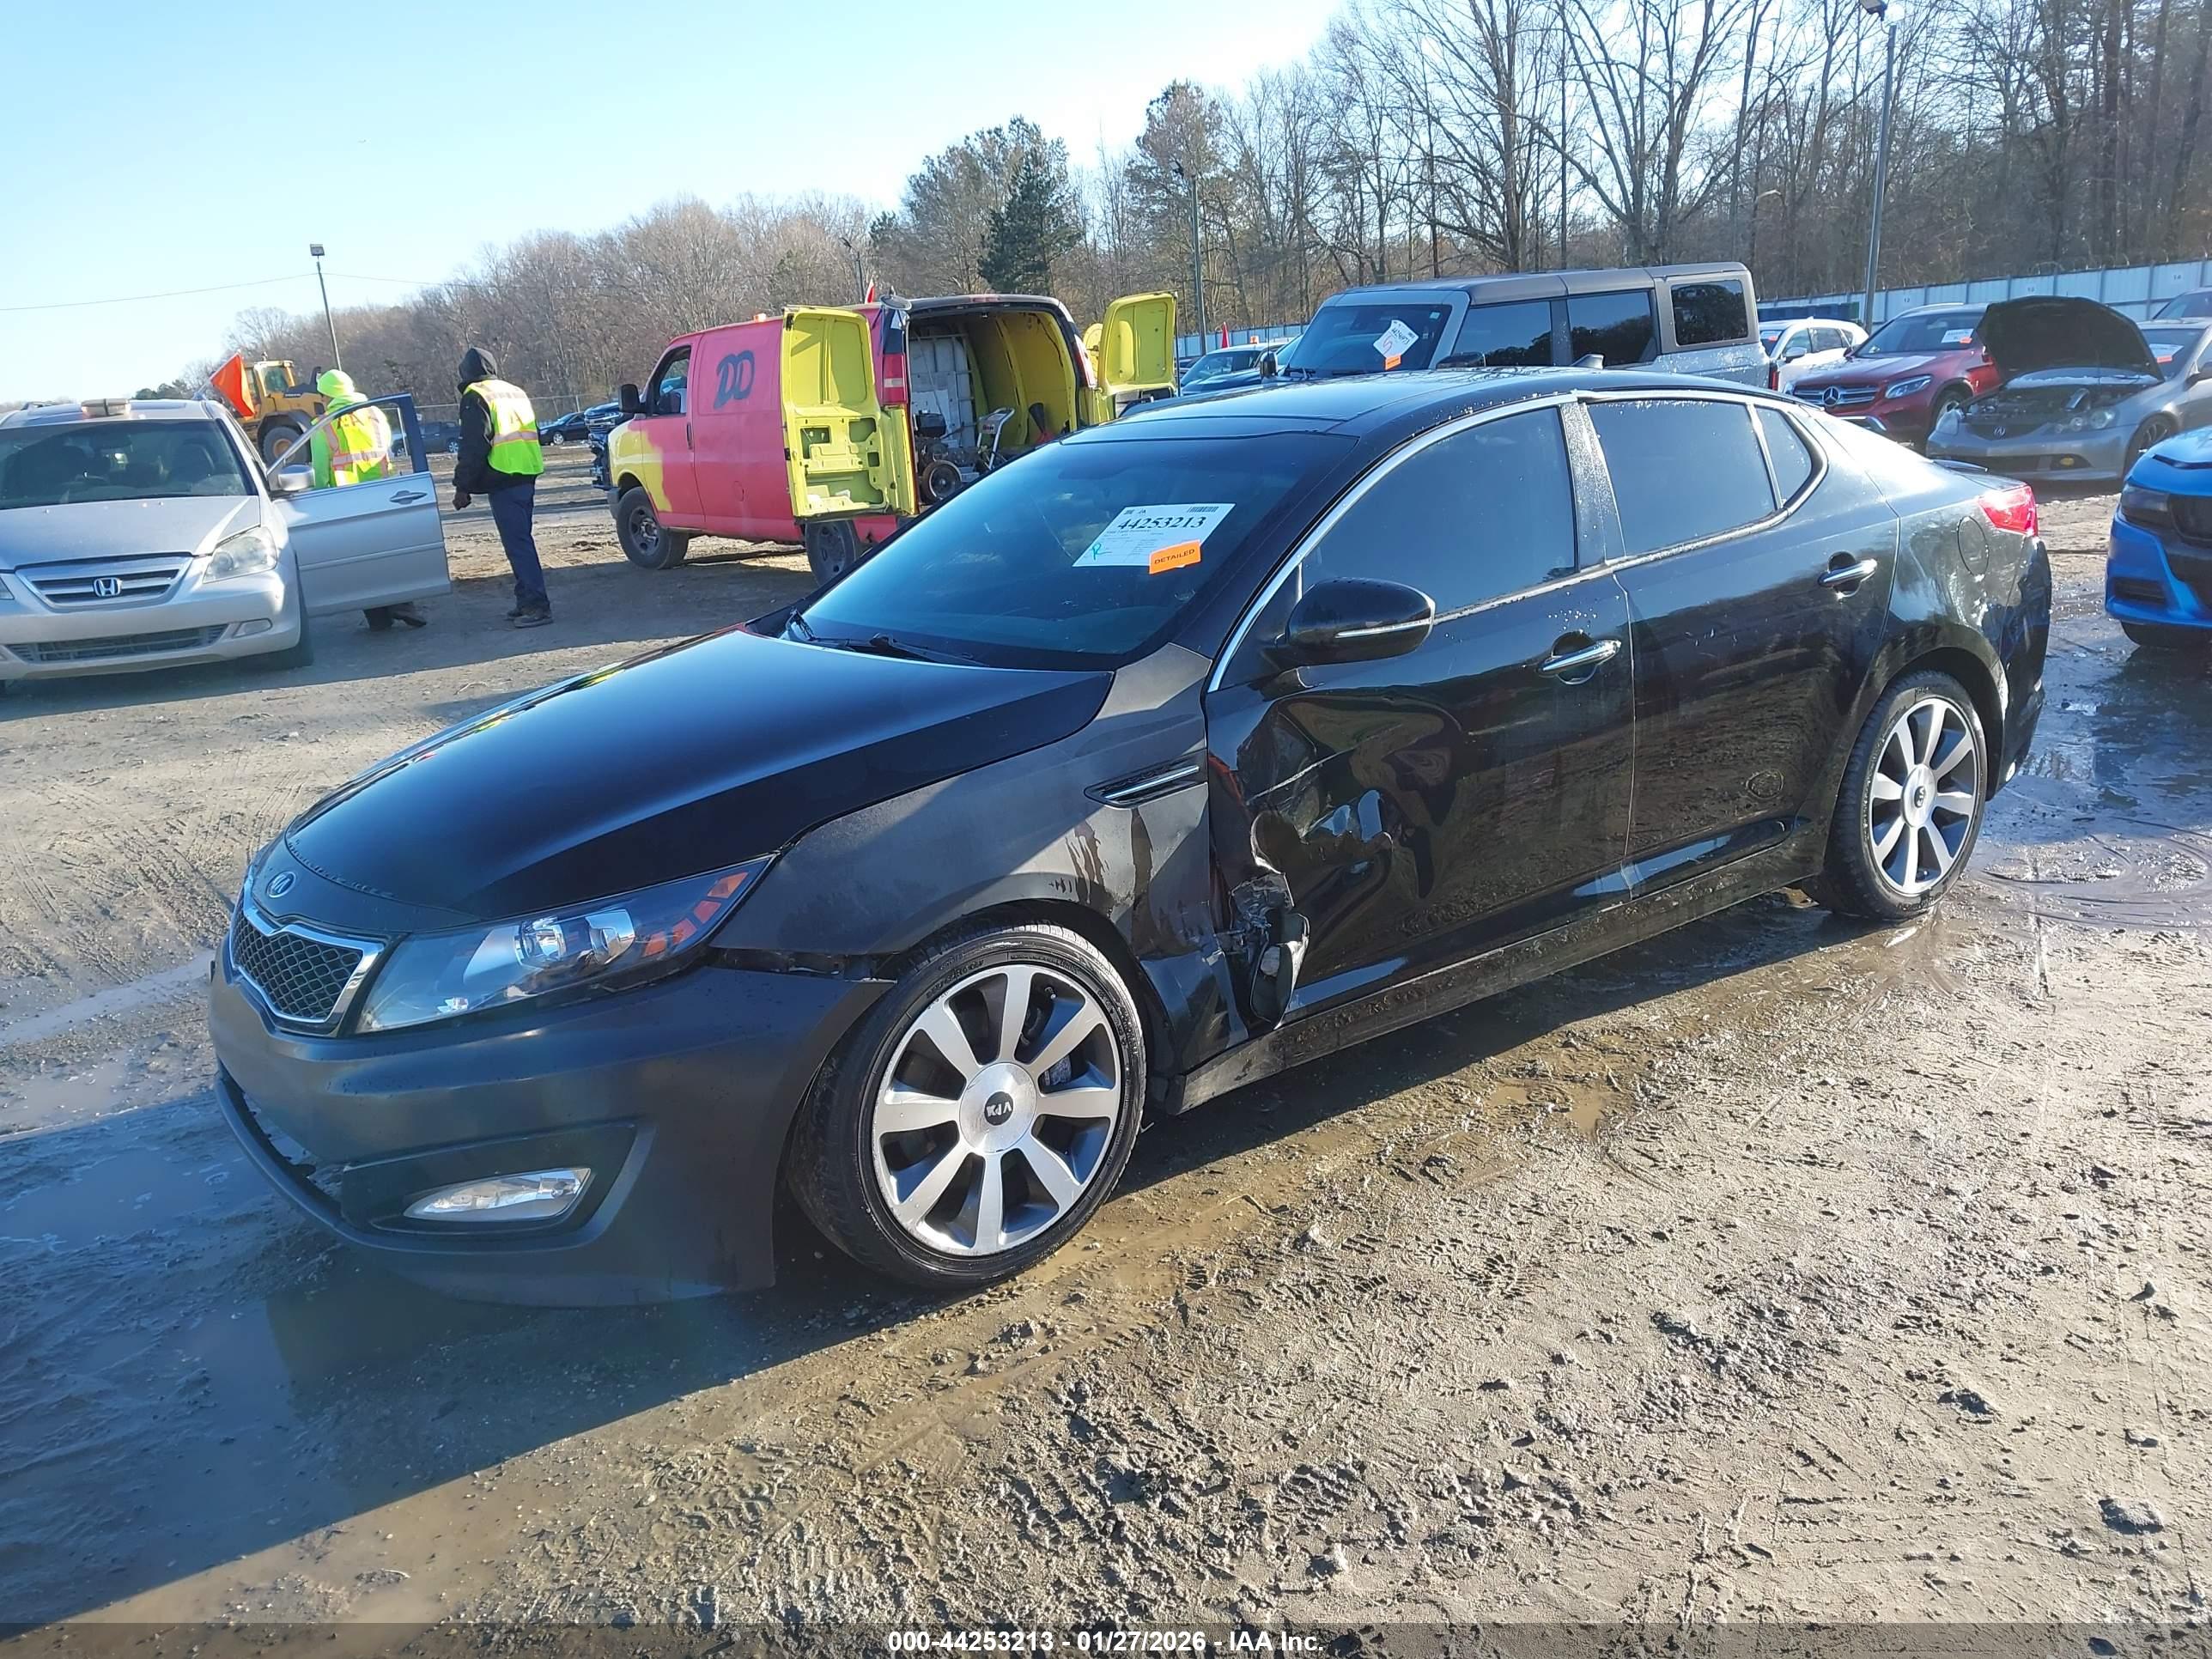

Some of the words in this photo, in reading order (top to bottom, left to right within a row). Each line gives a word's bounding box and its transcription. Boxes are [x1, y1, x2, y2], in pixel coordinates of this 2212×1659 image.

[1117, 516, 1206, 530] 44253213
[1154, 548, 1195, 565] DETAILED
[986, 1101, 1012, 1117] KIA
